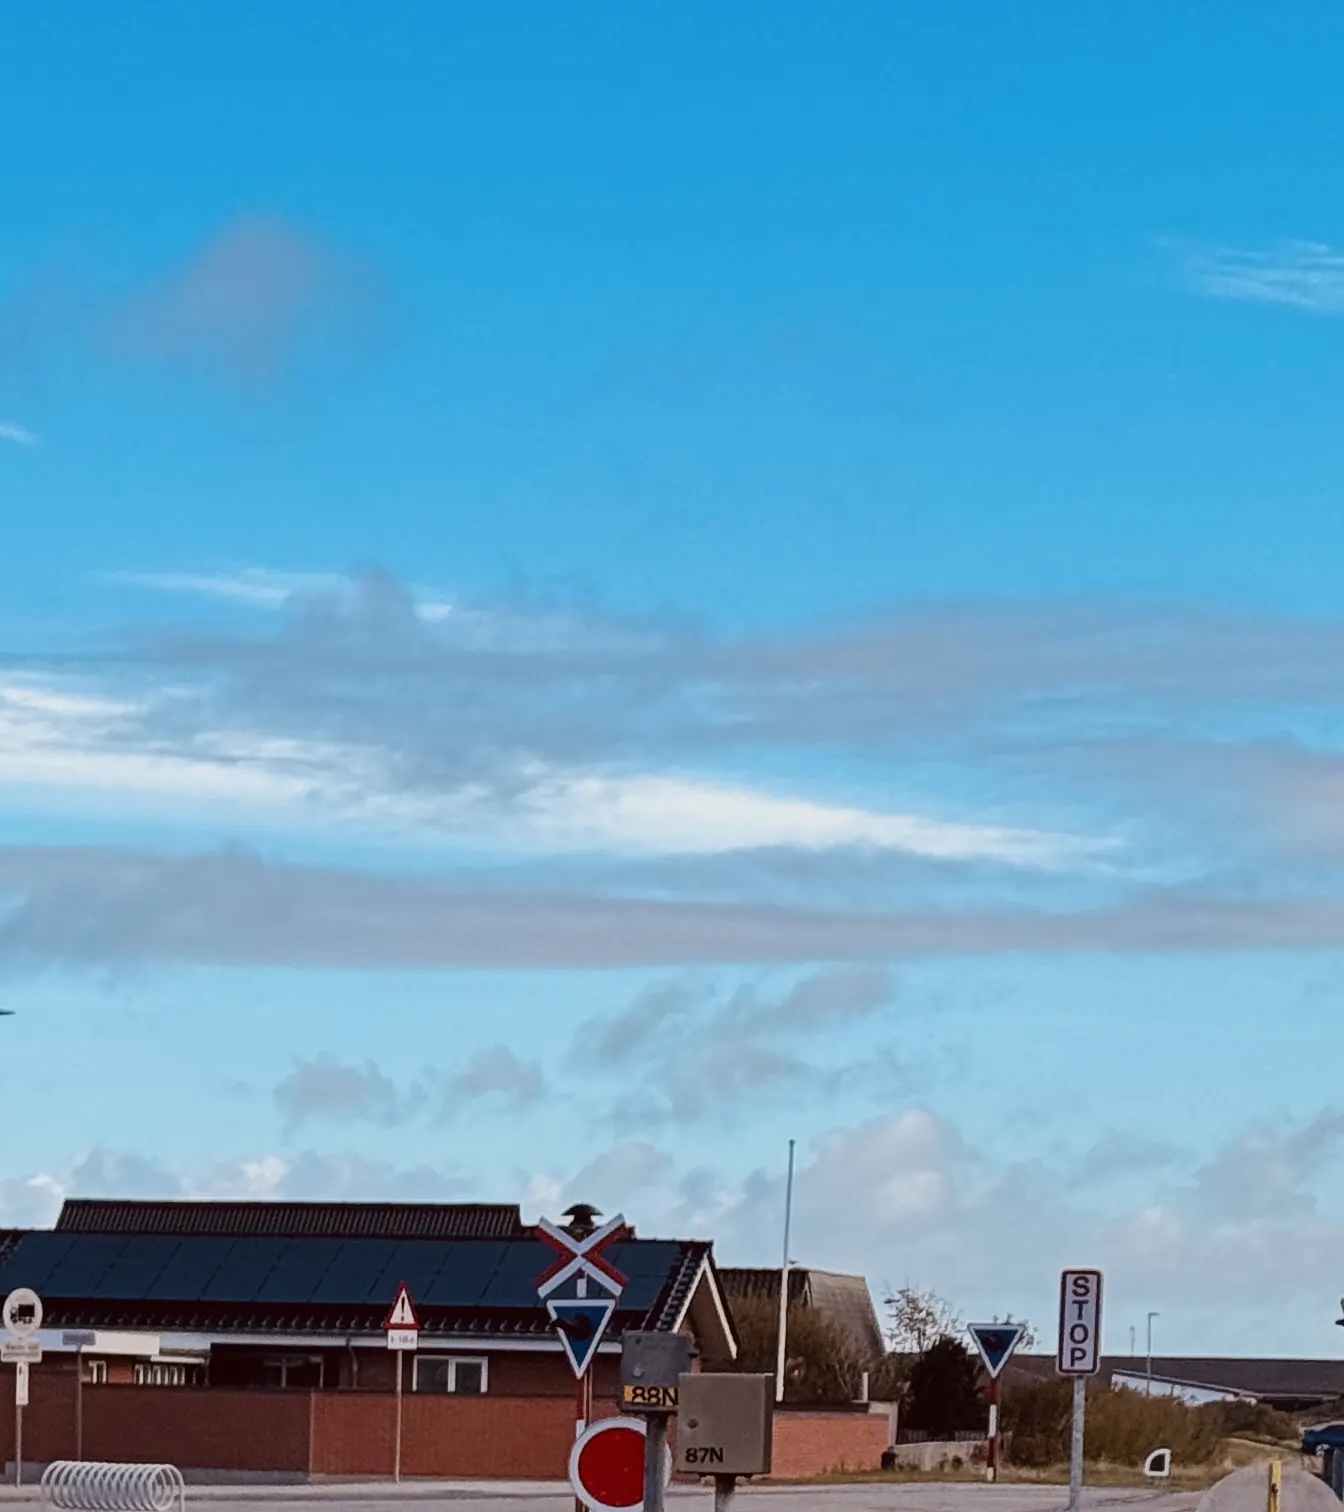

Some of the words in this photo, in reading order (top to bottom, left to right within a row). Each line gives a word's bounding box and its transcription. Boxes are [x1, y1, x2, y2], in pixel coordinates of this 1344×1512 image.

[1070, 1276, 1090, 1367] STOP
[632, 1386, 678, 1406] 88N
[685, 1447, 724, 1463] 87N
